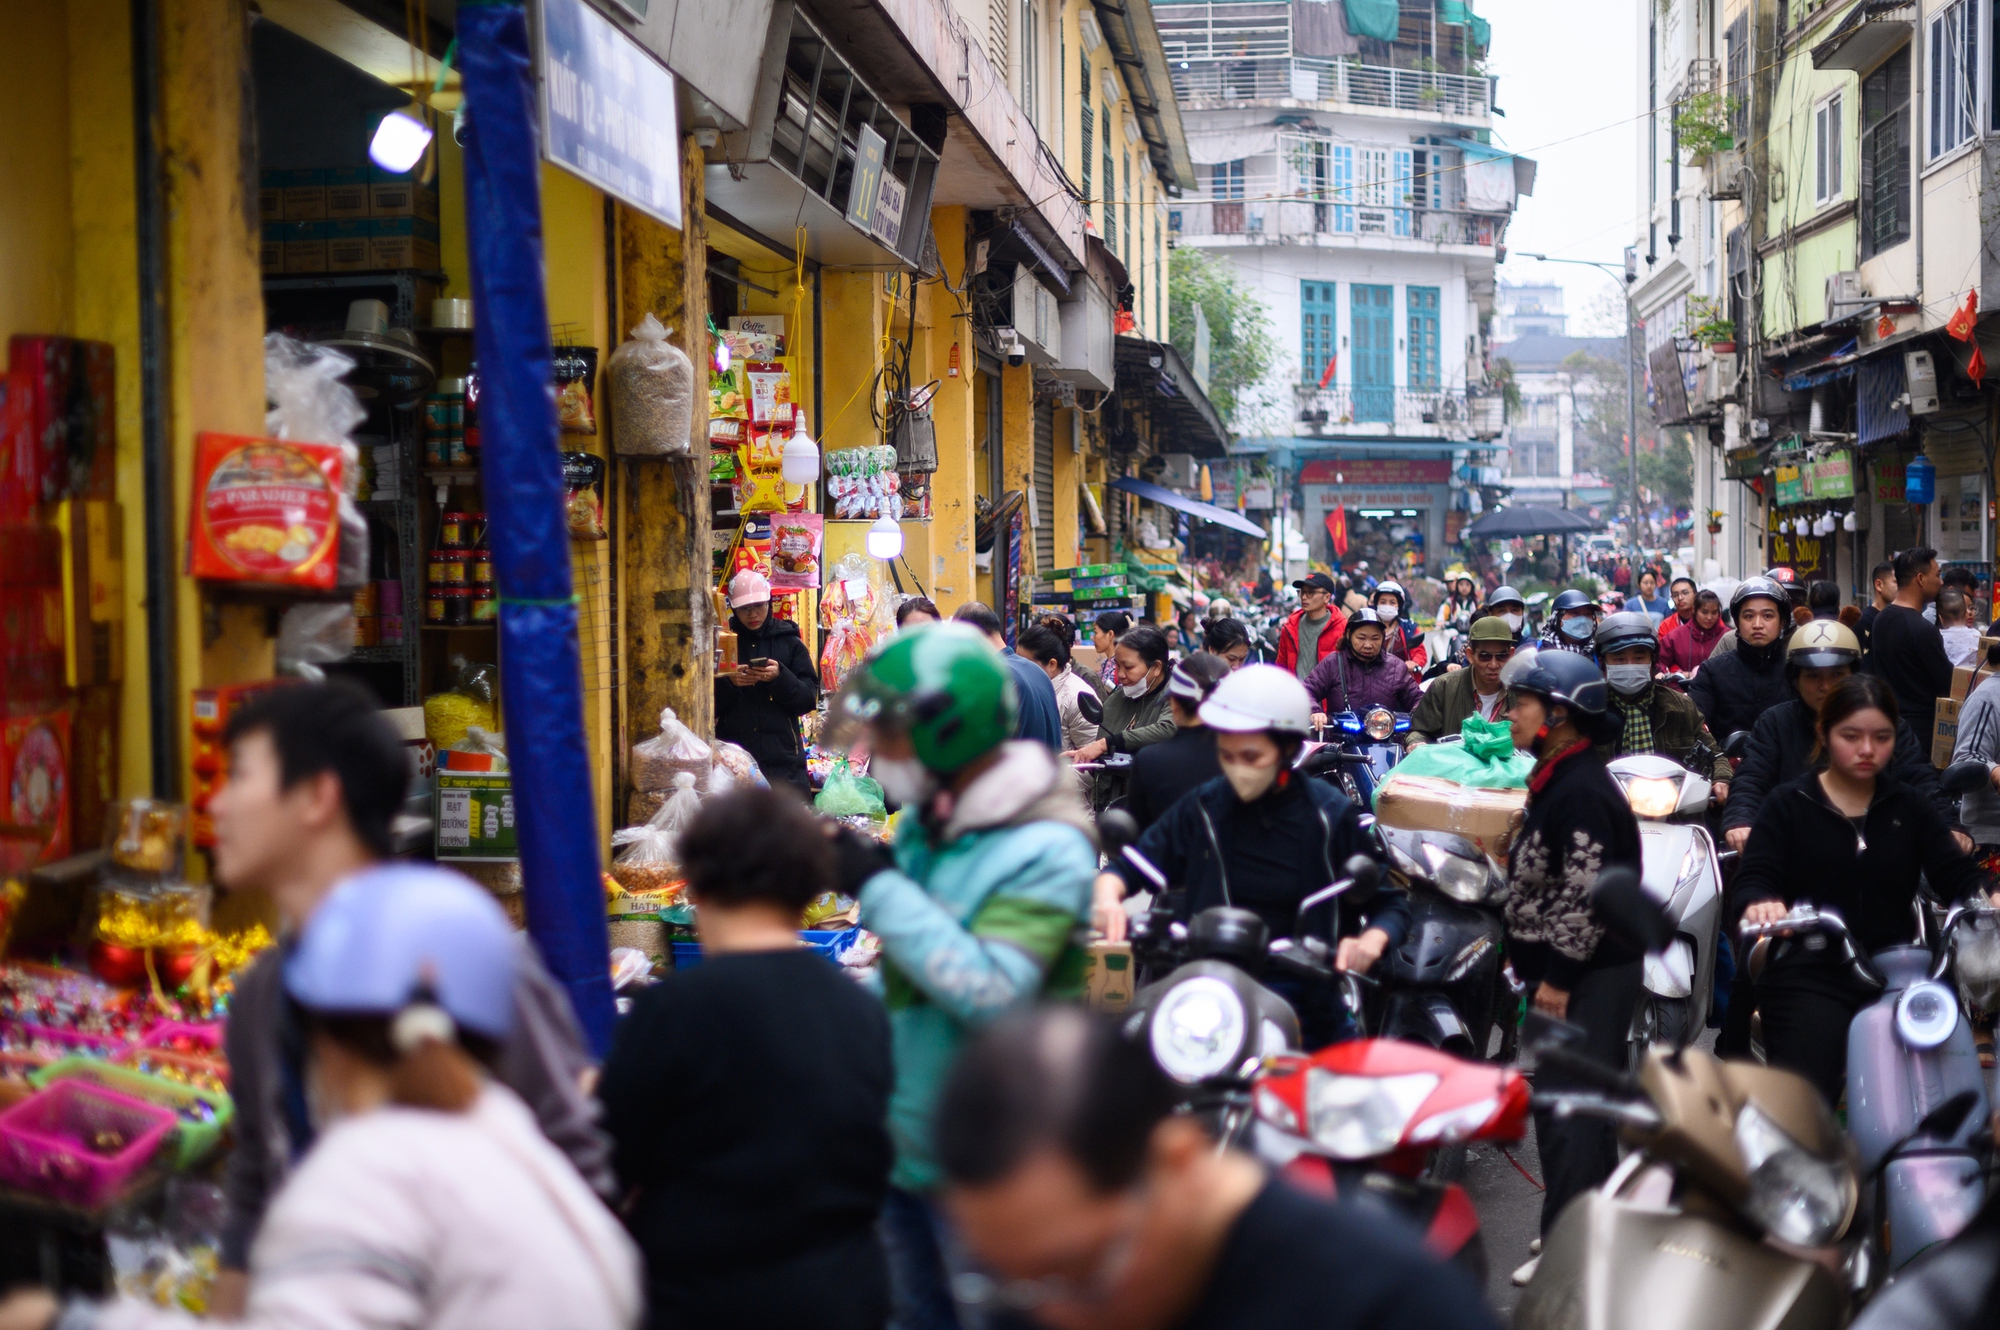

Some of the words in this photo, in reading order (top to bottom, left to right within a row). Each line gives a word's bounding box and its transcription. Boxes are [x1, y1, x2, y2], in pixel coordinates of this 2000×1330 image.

[581, 79, 595, 135] 12
[856, 167, 874, 221] 11
[742, 320, 765, 332] Coffee
[552, 357, 582, 368] ake-up
[562, 463, 593, 474] ake-up
[1796, 535, 1821, 570] Shop
[446, 802, 462, 813] HẠT
[441, 816, 468, 829] HƯỚNG
[440, 836, 468, 846] DƯƠNG
